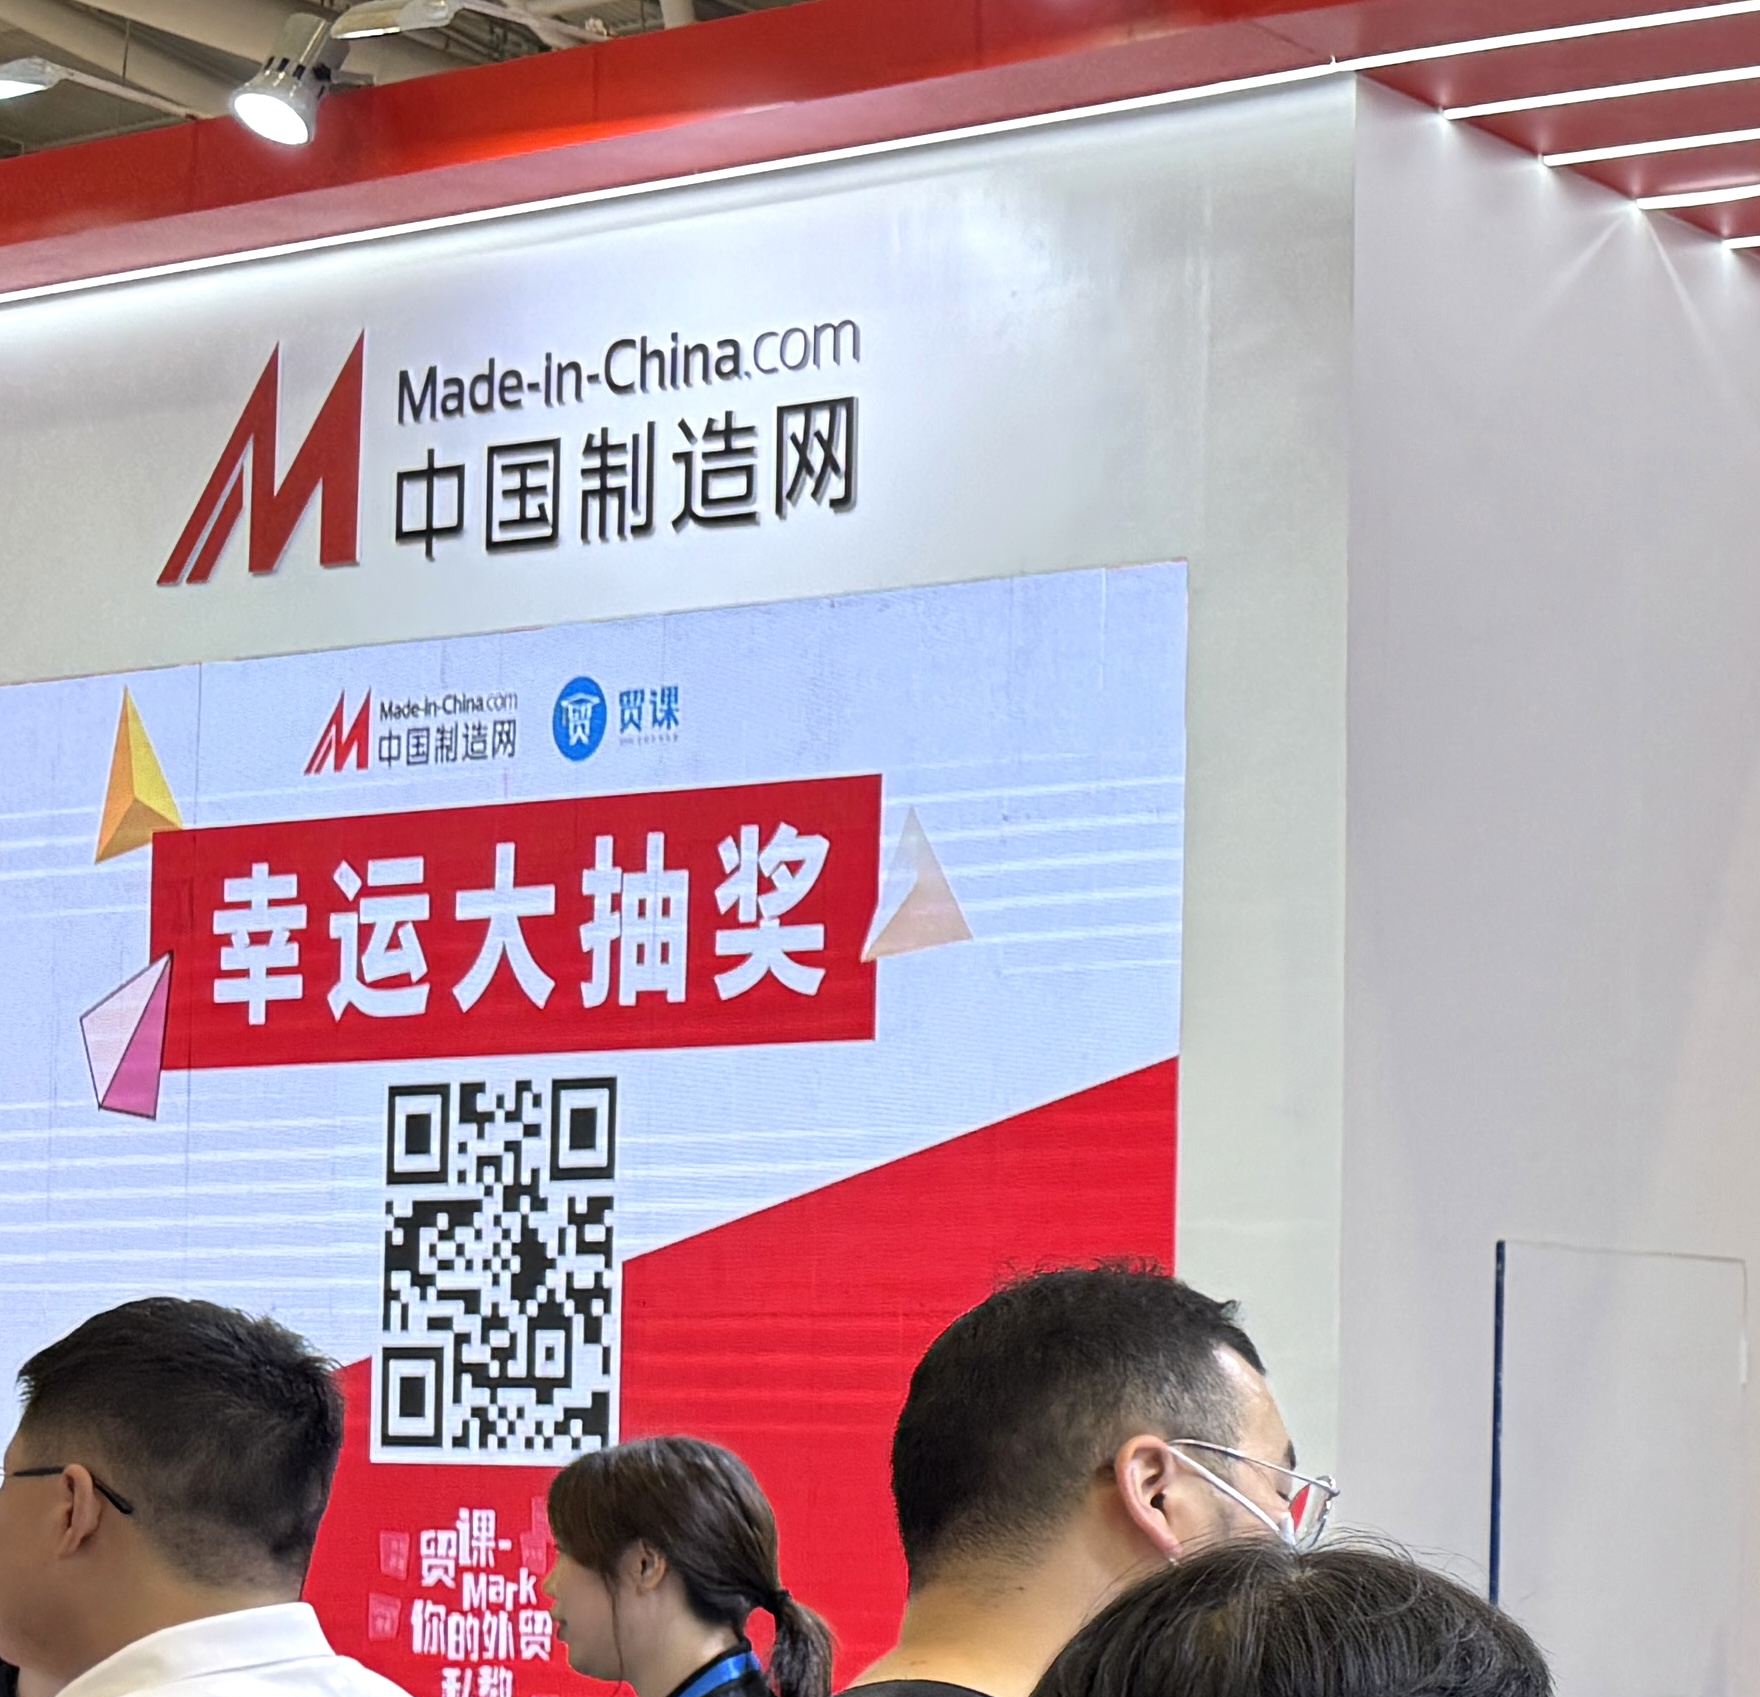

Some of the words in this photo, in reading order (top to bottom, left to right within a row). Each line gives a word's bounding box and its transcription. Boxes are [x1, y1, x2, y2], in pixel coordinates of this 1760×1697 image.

[396, 318, 862, 426] Made-in-China.com
[395, 396, 860, 561] 中国制造网
[619, 685, 681, 733] 贸课
[378, 719, 517, 768] 中国制造网
[212, 821, 832, 1027] 幸运大抽奖
[462, 1567, 537, 1611] Mark
[411, 1598, 553, 1663] 你的外贸
